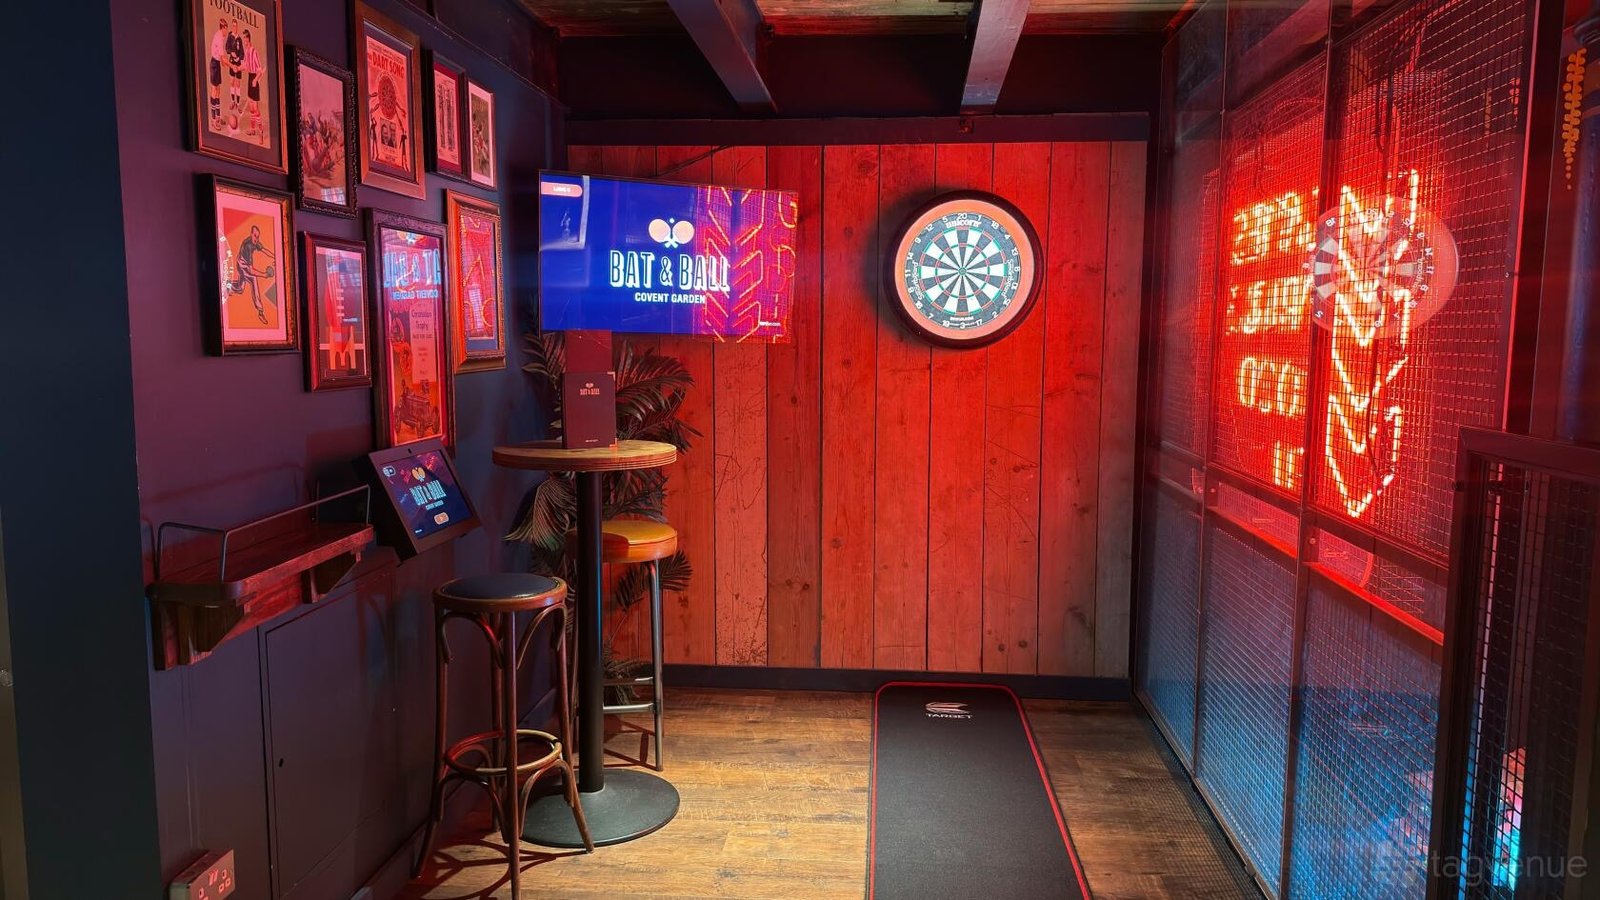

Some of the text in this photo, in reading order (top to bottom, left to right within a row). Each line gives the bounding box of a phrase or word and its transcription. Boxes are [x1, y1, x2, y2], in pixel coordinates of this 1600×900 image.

[957, 212, 968, 220] 20
[925, 223, 935, 232] 12
[610, 250, 730, 292] BAT & BALL
[635, 292, 706, 304] COVENT GARDEN
[992, 311, 998, 319] 2
[960, 321, 966, 329] 3
